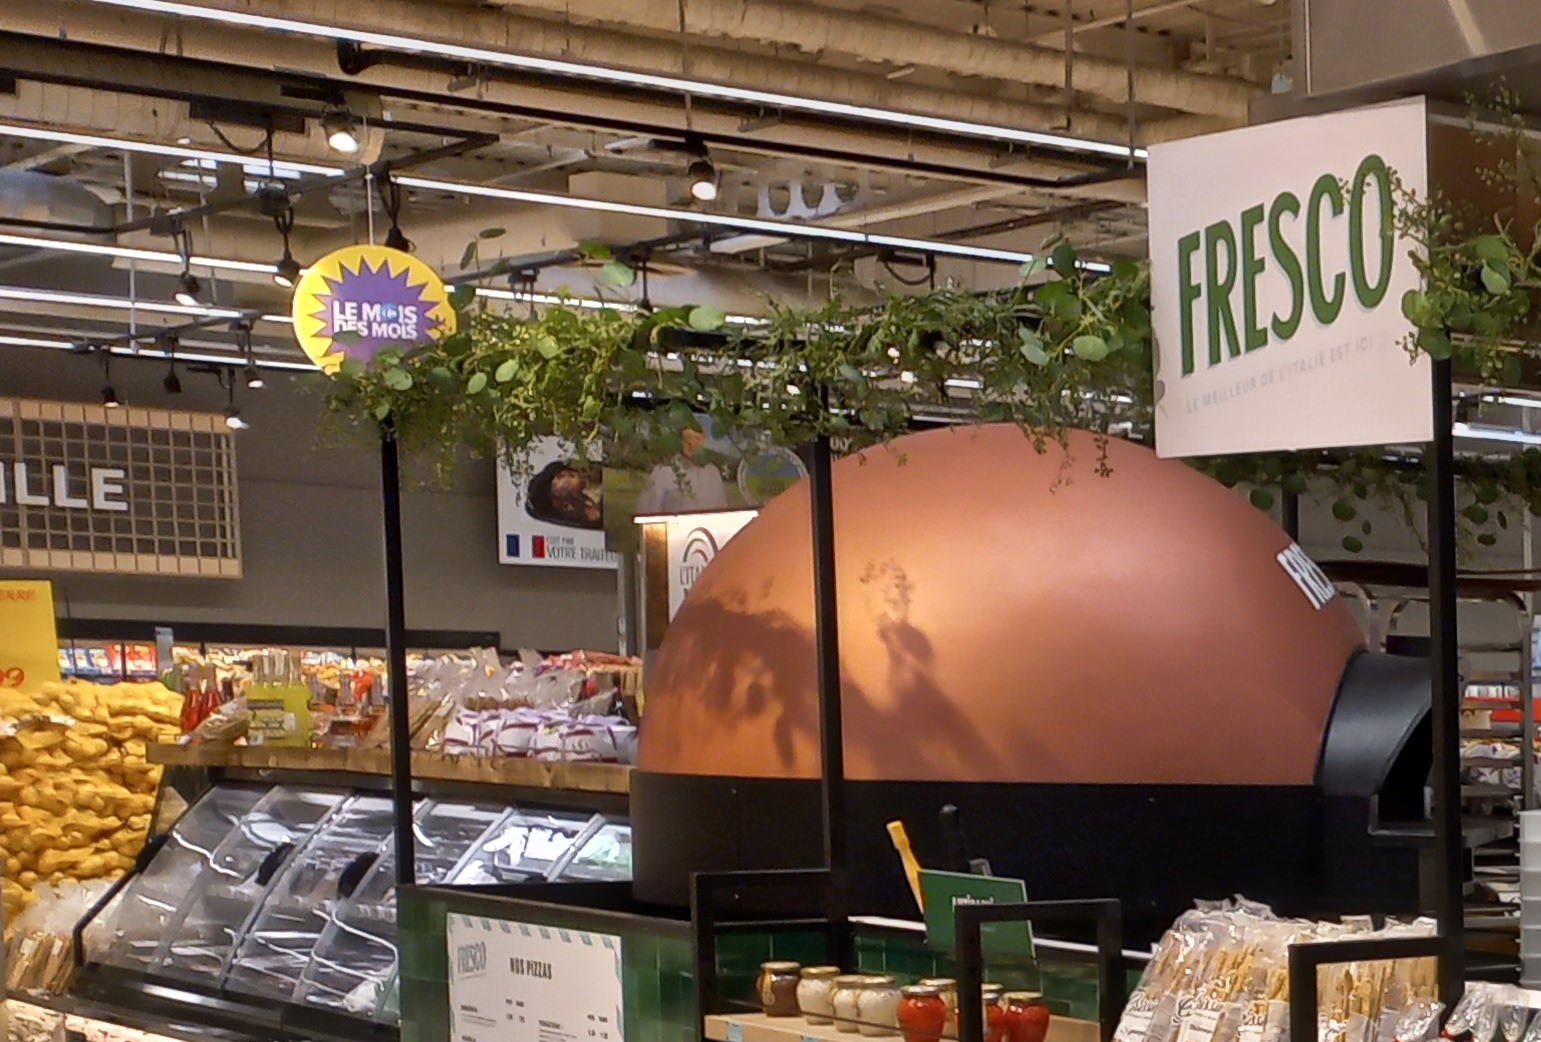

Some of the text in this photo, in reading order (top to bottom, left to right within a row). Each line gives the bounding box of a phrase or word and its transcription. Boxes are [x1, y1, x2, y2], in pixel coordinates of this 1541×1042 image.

[1178, 154, 1395, 378] FRESCO
[333, 300, 417, 324] LE MIS
[371, 321, 417, 340] MOIS
[1202, 377, 1257, 408] MEILLEUR
[526, 960, 552, 981] PIZZAS
